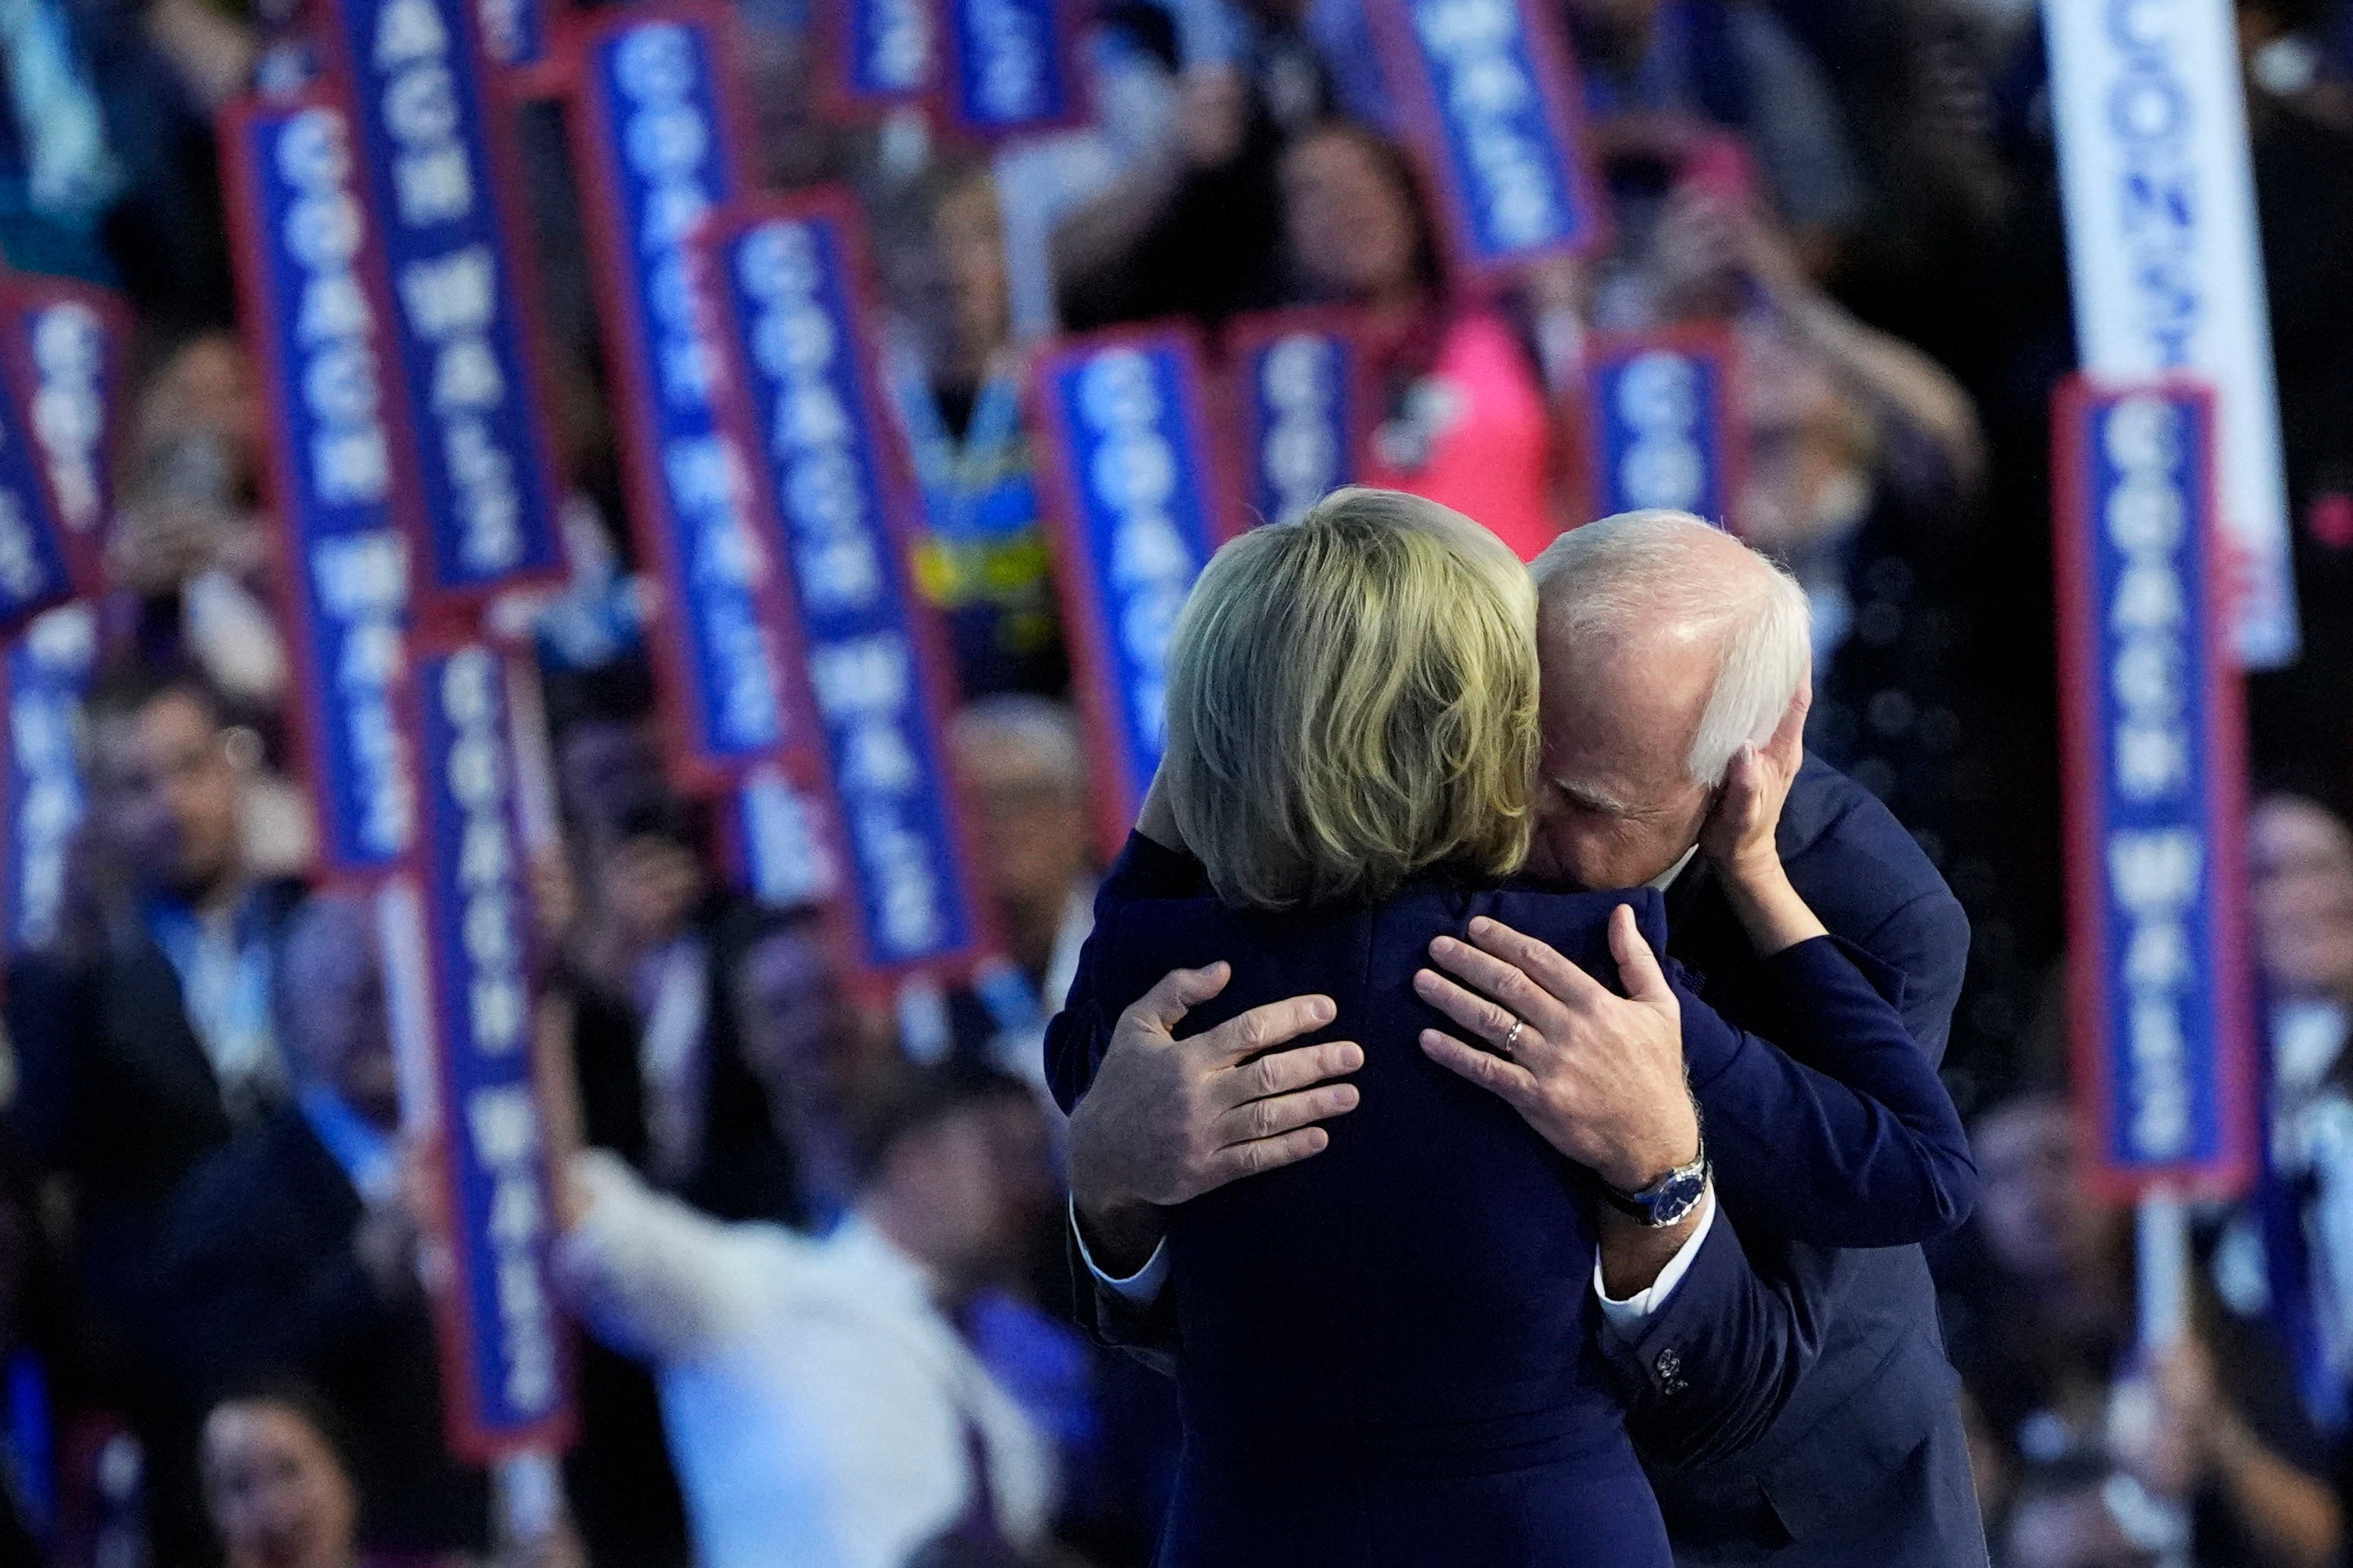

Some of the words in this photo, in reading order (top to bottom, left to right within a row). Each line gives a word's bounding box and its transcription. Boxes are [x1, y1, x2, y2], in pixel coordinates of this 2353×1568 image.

[276, 105, 388, 504] COACH
[399, 243, 523, 574] WALZ
[739, 220, 879, 609] COACH
[811, 631, 938, 952] WALZ
[2104, 400, 2188, 799] COACH
[441, 646, 526, 1050] COACH
[2107, 826, 2204, 1156] WALZ
[466, 1084, 557, 1416] WALZ
